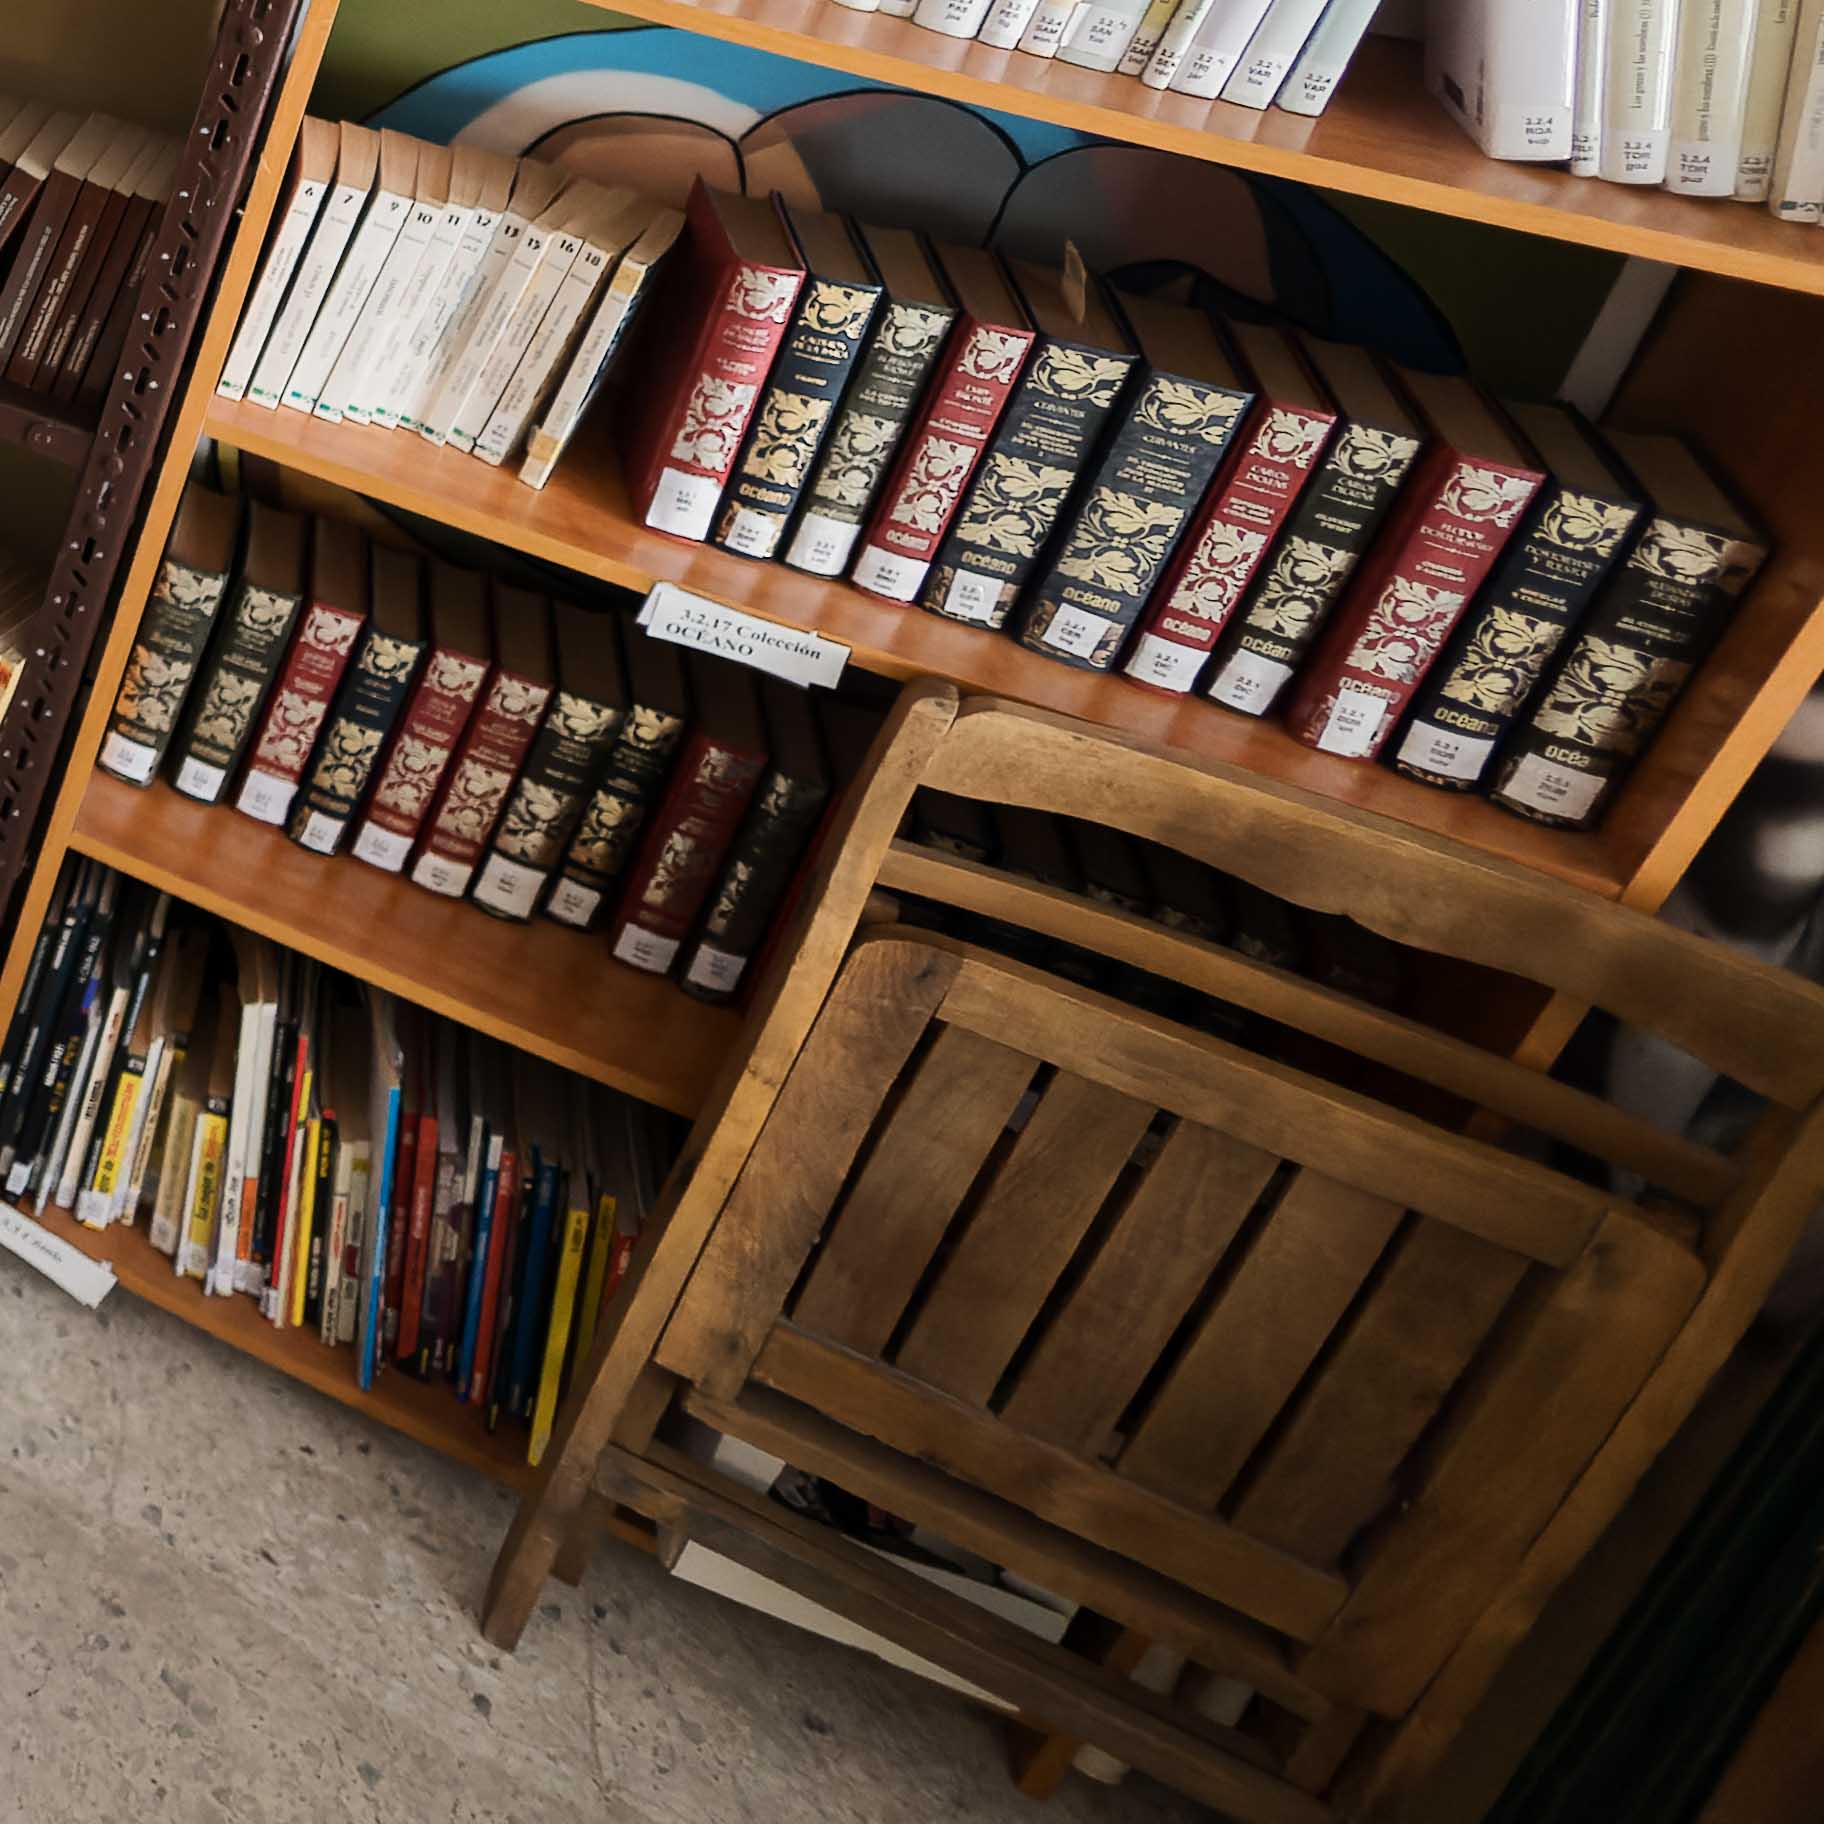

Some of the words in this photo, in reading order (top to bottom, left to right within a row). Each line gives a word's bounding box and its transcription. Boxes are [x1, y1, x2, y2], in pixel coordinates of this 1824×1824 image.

[1679, 152, 1711, 164] 3.2.4
[304, 186, 315, 197] 6
[344, 192, 354, 205] 7
[389, 201, 400, 213] 9
[416, 212, 433, 225] 10
[446, 213, 461, 226] 11
[475, 214, 492, 228] 12
[503, 224, 520, 239] 13
[527, 237, 542, 252] 15
[559, 239, 575, 254] 16
[584, 251, 601, 266] 18
[960, 549, 1017, 575] océano
[1061, 585, 1122, 615] océano
[680, 609, 732, 633] 3.2.17
[736, 618, 823, 660] Colección
[1161, 617, 1212, 641] océano
[665, 620, 755, 658] OCÉANO
